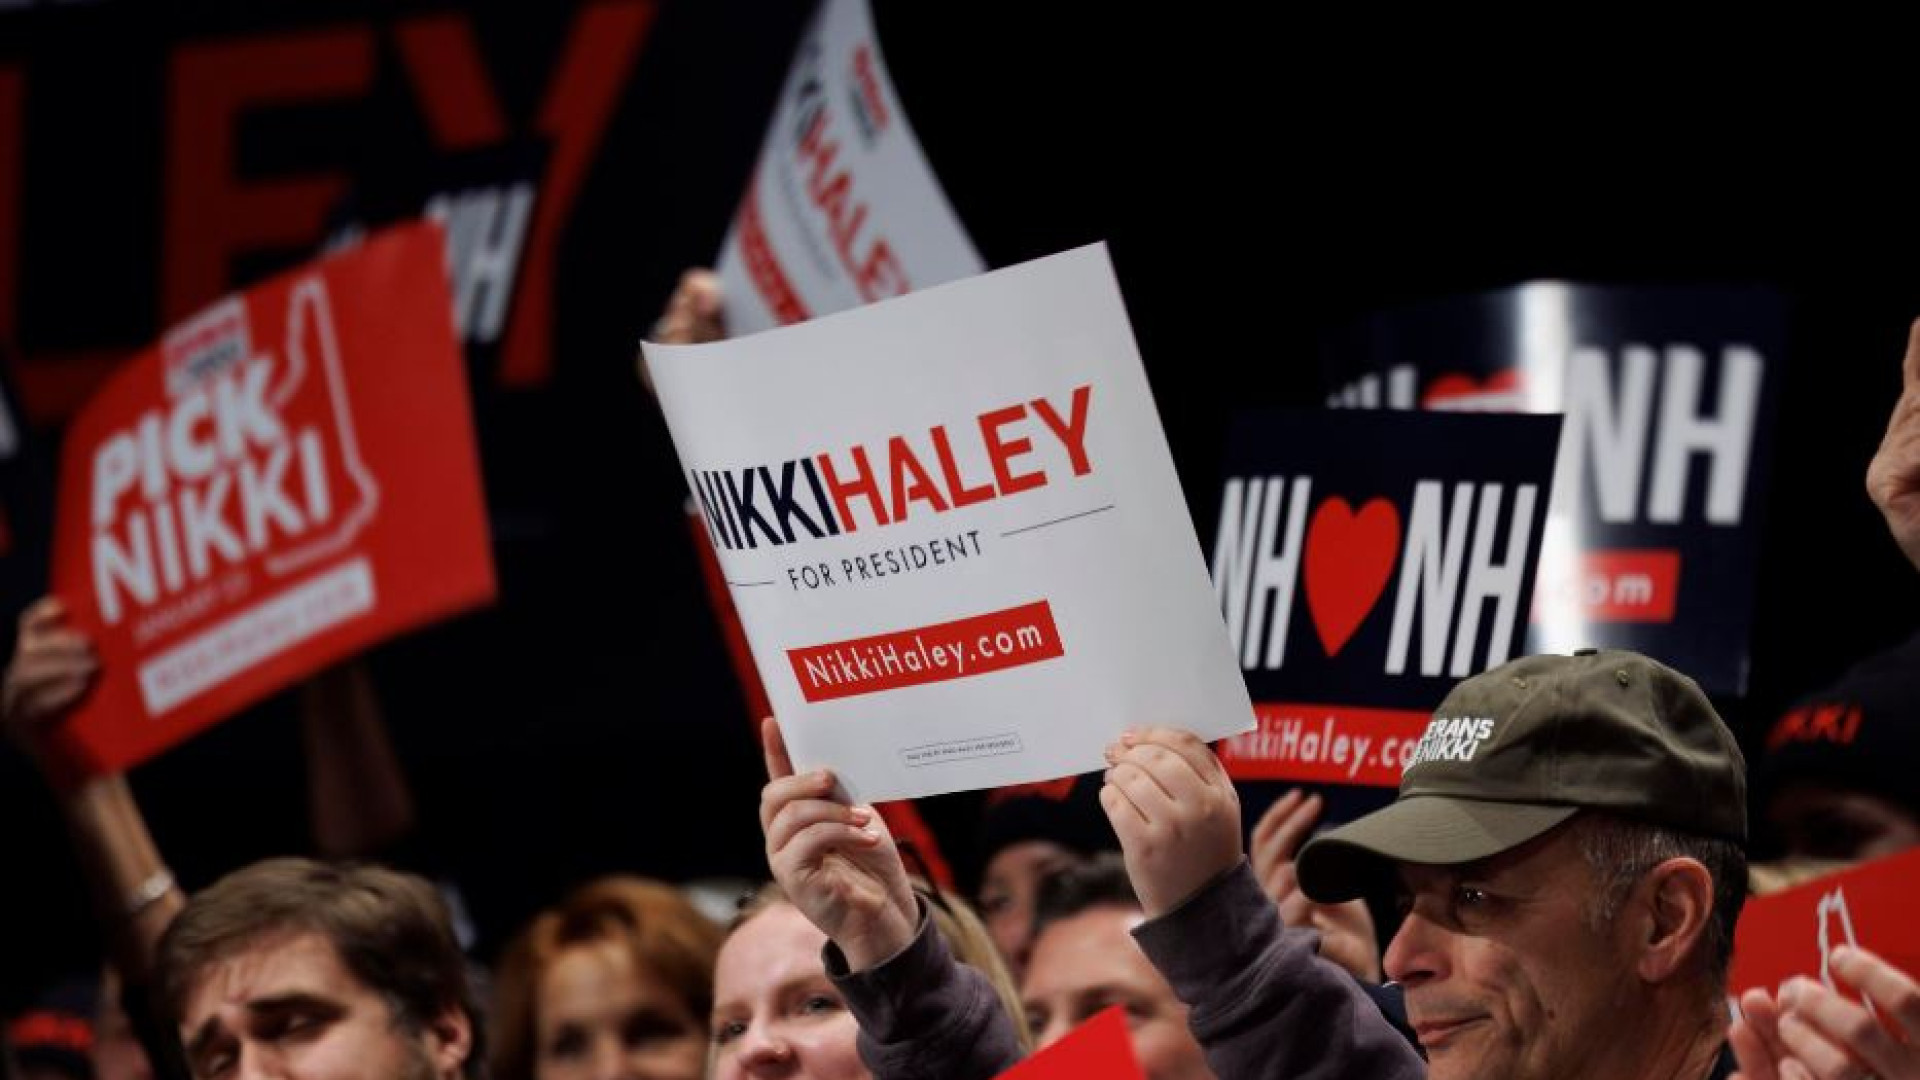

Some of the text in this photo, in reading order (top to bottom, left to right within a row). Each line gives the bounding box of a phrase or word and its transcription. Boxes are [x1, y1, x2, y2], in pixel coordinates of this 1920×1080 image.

[92, 354, 286, 531] PICK
[1562, 342, 1764, 525] NH
[92, 427, 330, 625] NIKKI
[787, 530, 985, 591] FOR PRESIDENT
[1213, 476, 1538, 678] NH NH
[802, 623, 1043, 688] NikkiHaley.com
